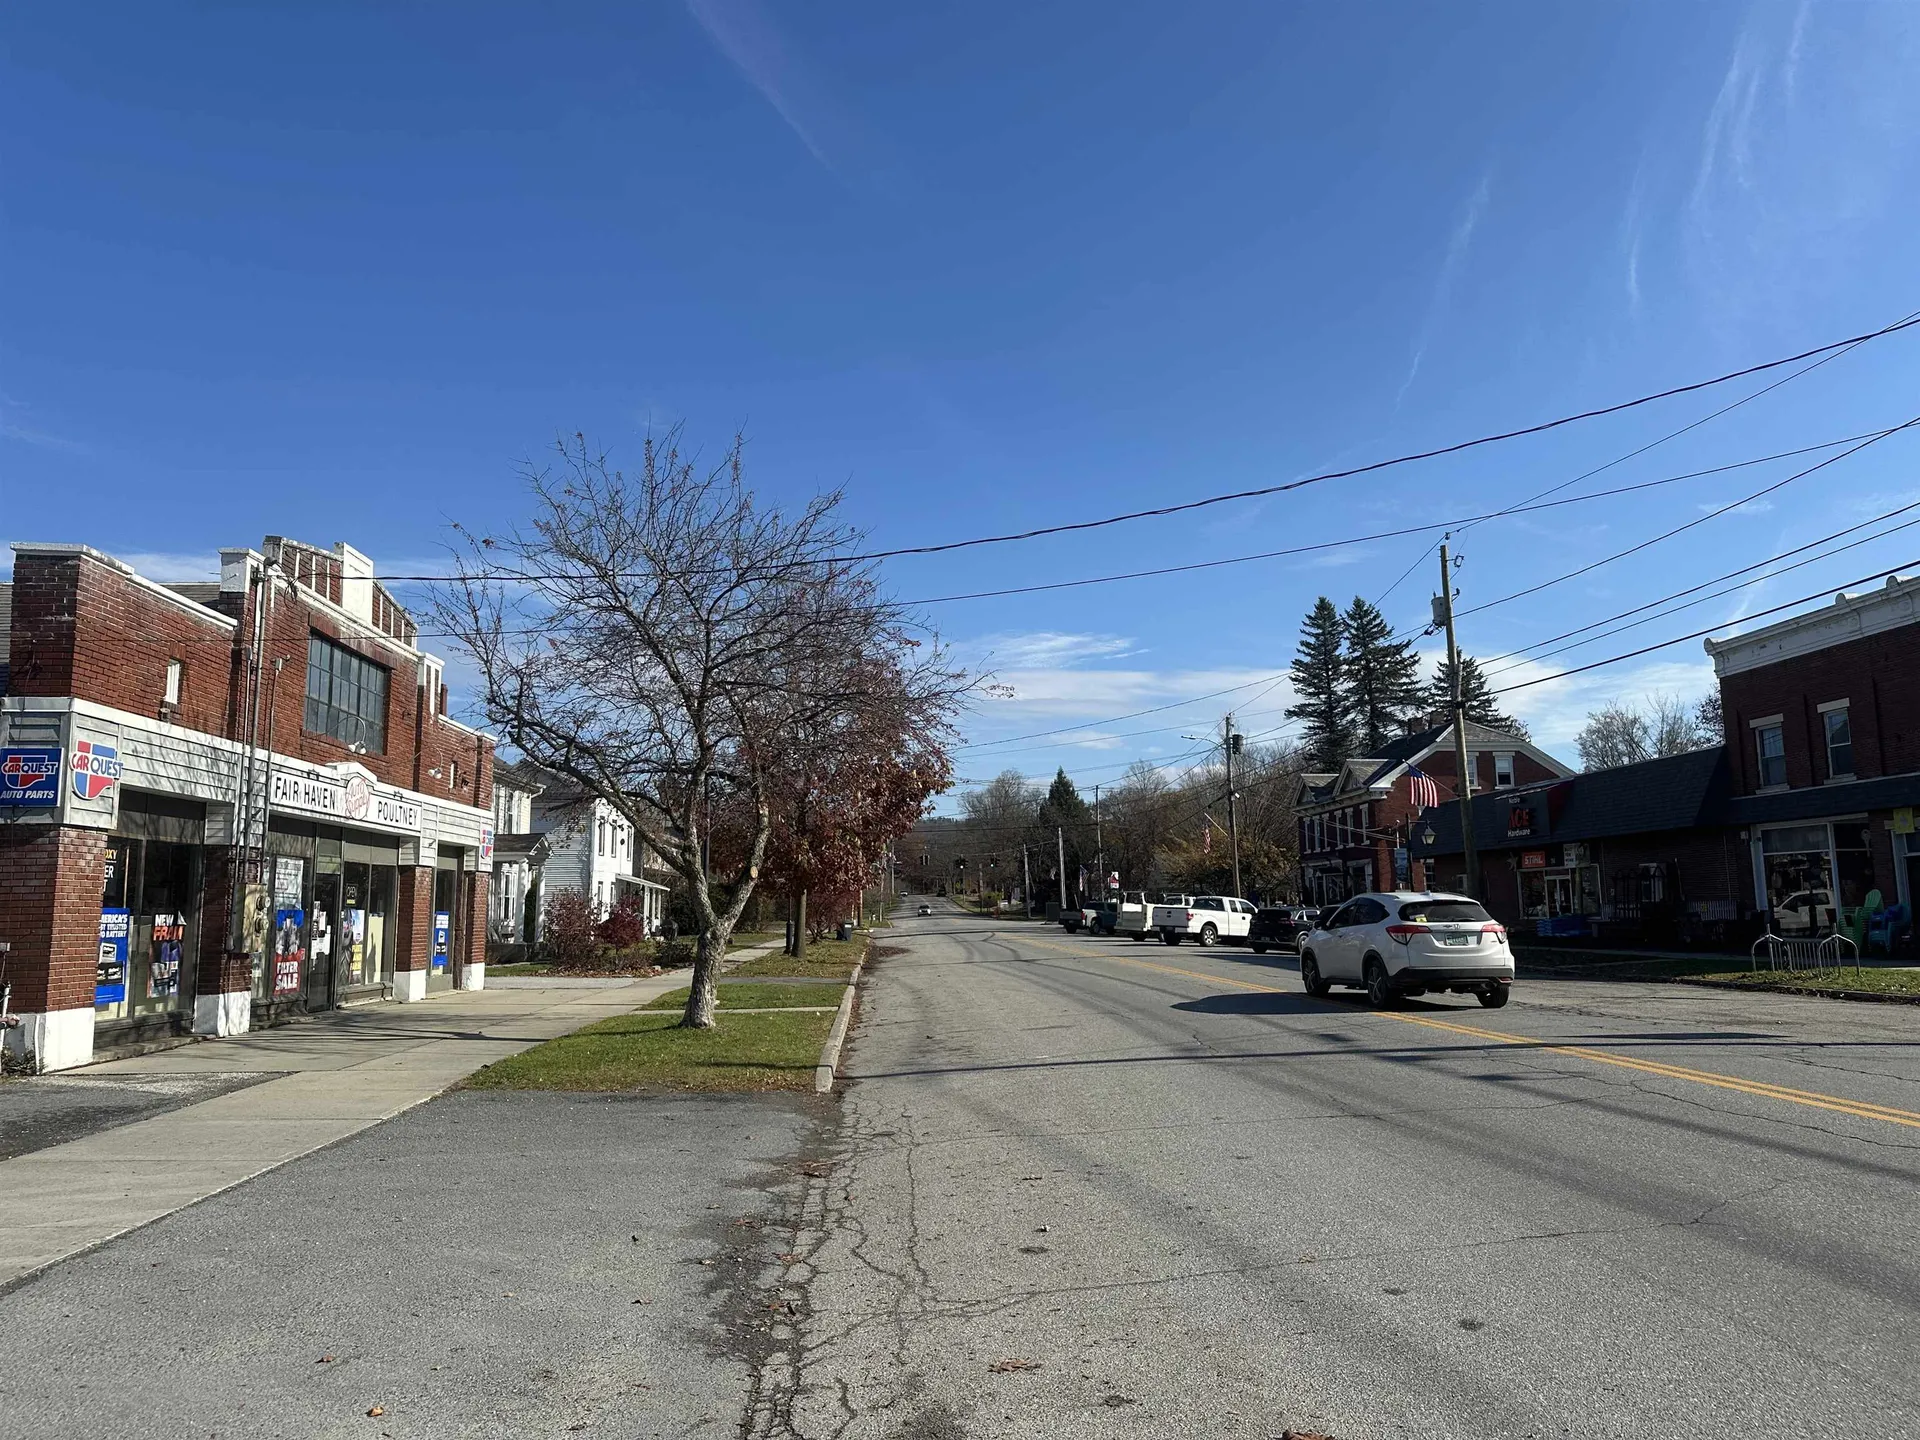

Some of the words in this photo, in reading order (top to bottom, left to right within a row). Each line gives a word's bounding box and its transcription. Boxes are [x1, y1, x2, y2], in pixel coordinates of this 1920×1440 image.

[1, 763, 57, 773] CARQUEST
[71, 753, 123, 777] CARQUEST
[1, 790, 22, 799] AUTO
[25, 790, 54, 799] PARTS
[275, 776, 299, 802] FAIR
[303, 783, 336, 810] HAVEN
[377, 800, 418, 826] POULTNEY
[1508, 808, 1529, 829] ACE
[1507, 828, 1531, 838] Hardware
[1524, 855, 1543, 865] STIHL
[155, 914, 174, 926] NEW
[277, 961, 298, 974] FILTER
[275, 974, 298, 991] SALE
